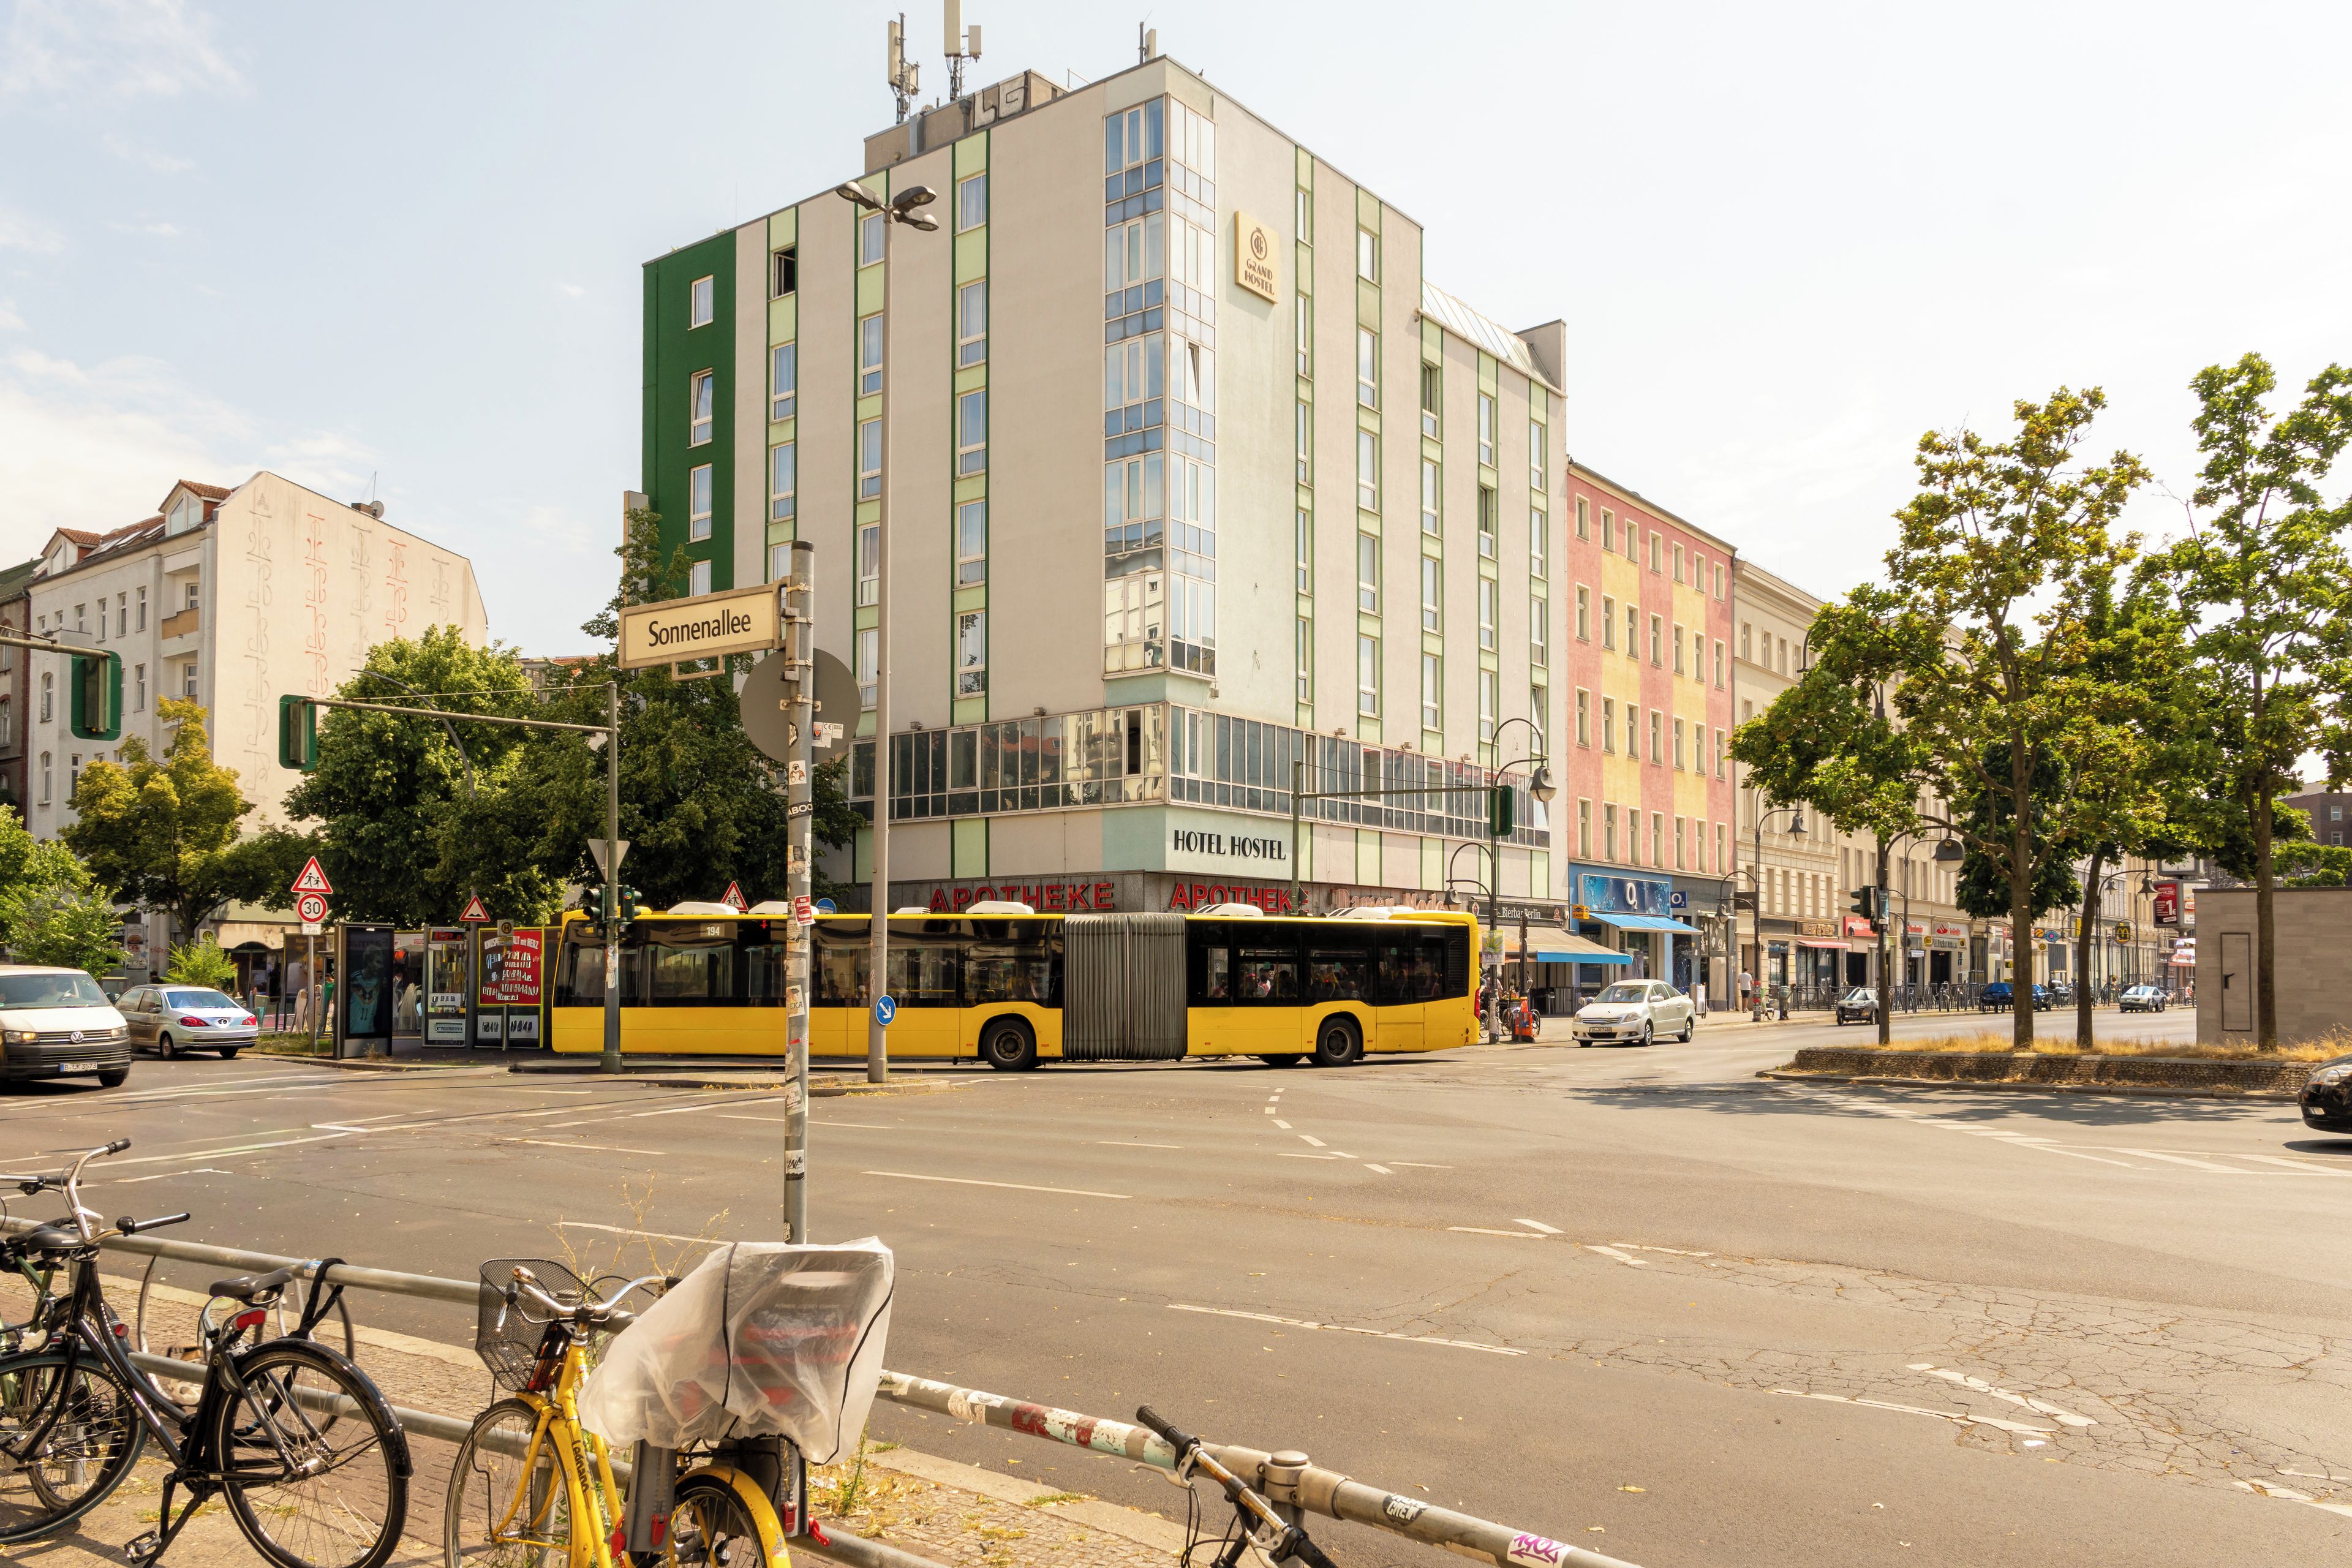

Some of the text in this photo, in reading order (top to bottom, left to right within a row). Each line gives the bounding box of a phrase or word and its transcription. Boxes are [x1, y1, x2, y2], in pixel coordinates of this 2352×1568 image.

[1245, 270, 1275, 295] HOSTEL
[1246, 258, 1273, 281] GRAND
[649, 609, 752, 647] Sonnenallee
[1174, 829, 1286, 861] HOTEL HOSTEL
[304, 902, 320, 914] 30
[929, 882, 1114, 913] APOTHEKE
[1170, 883, 1309, 913] APOTHEK
[1502, 907, 1541, 919] Bierbar Berlin
[706, 926, 720, 936] 194
[110, 1371, 136, 1408] SWAPFIETS
